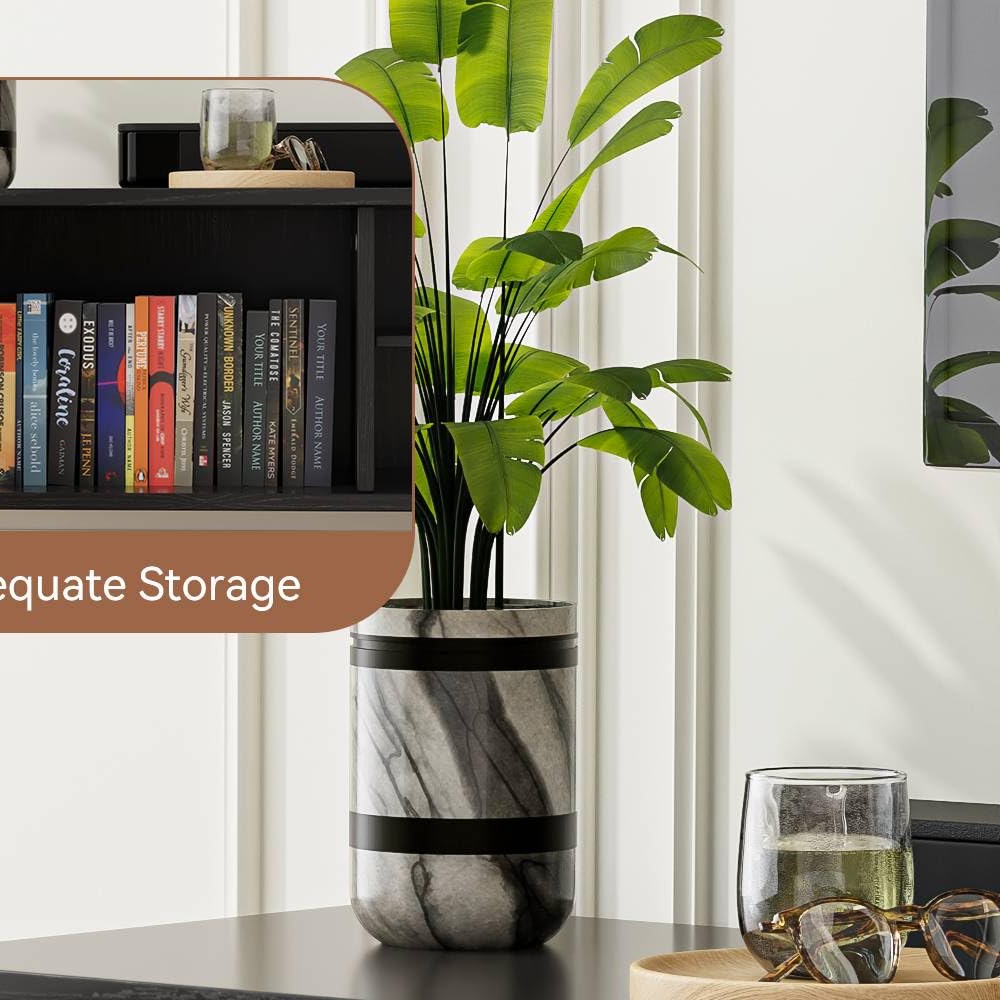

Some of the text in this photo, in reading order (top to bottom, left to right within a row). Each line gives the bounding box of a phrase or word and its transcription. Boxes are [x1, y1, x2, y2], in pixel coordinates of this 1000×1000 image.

[83, 320, 95, 370] EXODUS
[136, 330, 148, 370] PERFUME
[223, 306, 234, 392] UNKNOWN BORDER
[253, 332, 265, 386] YOUR TITLE
[269, 310, 280, 382] THE COMATOSE
[288, 306, 298, 360] SENTINEL
[316, 323, 326, 381] YOUR TITLE
[55, 348, 76, 427] Coraline
[30, 401, 42, 473] alice sebold
[82, 447, 92, 477] PENN
[222, 400, 232, 469] JASON SPENCER
[252, 400, 264, 470] AUTHOR NAME
[267, 421, 277, 480] KATE MYERS
[313, 395, 324, 470] AUTHOR NAME
